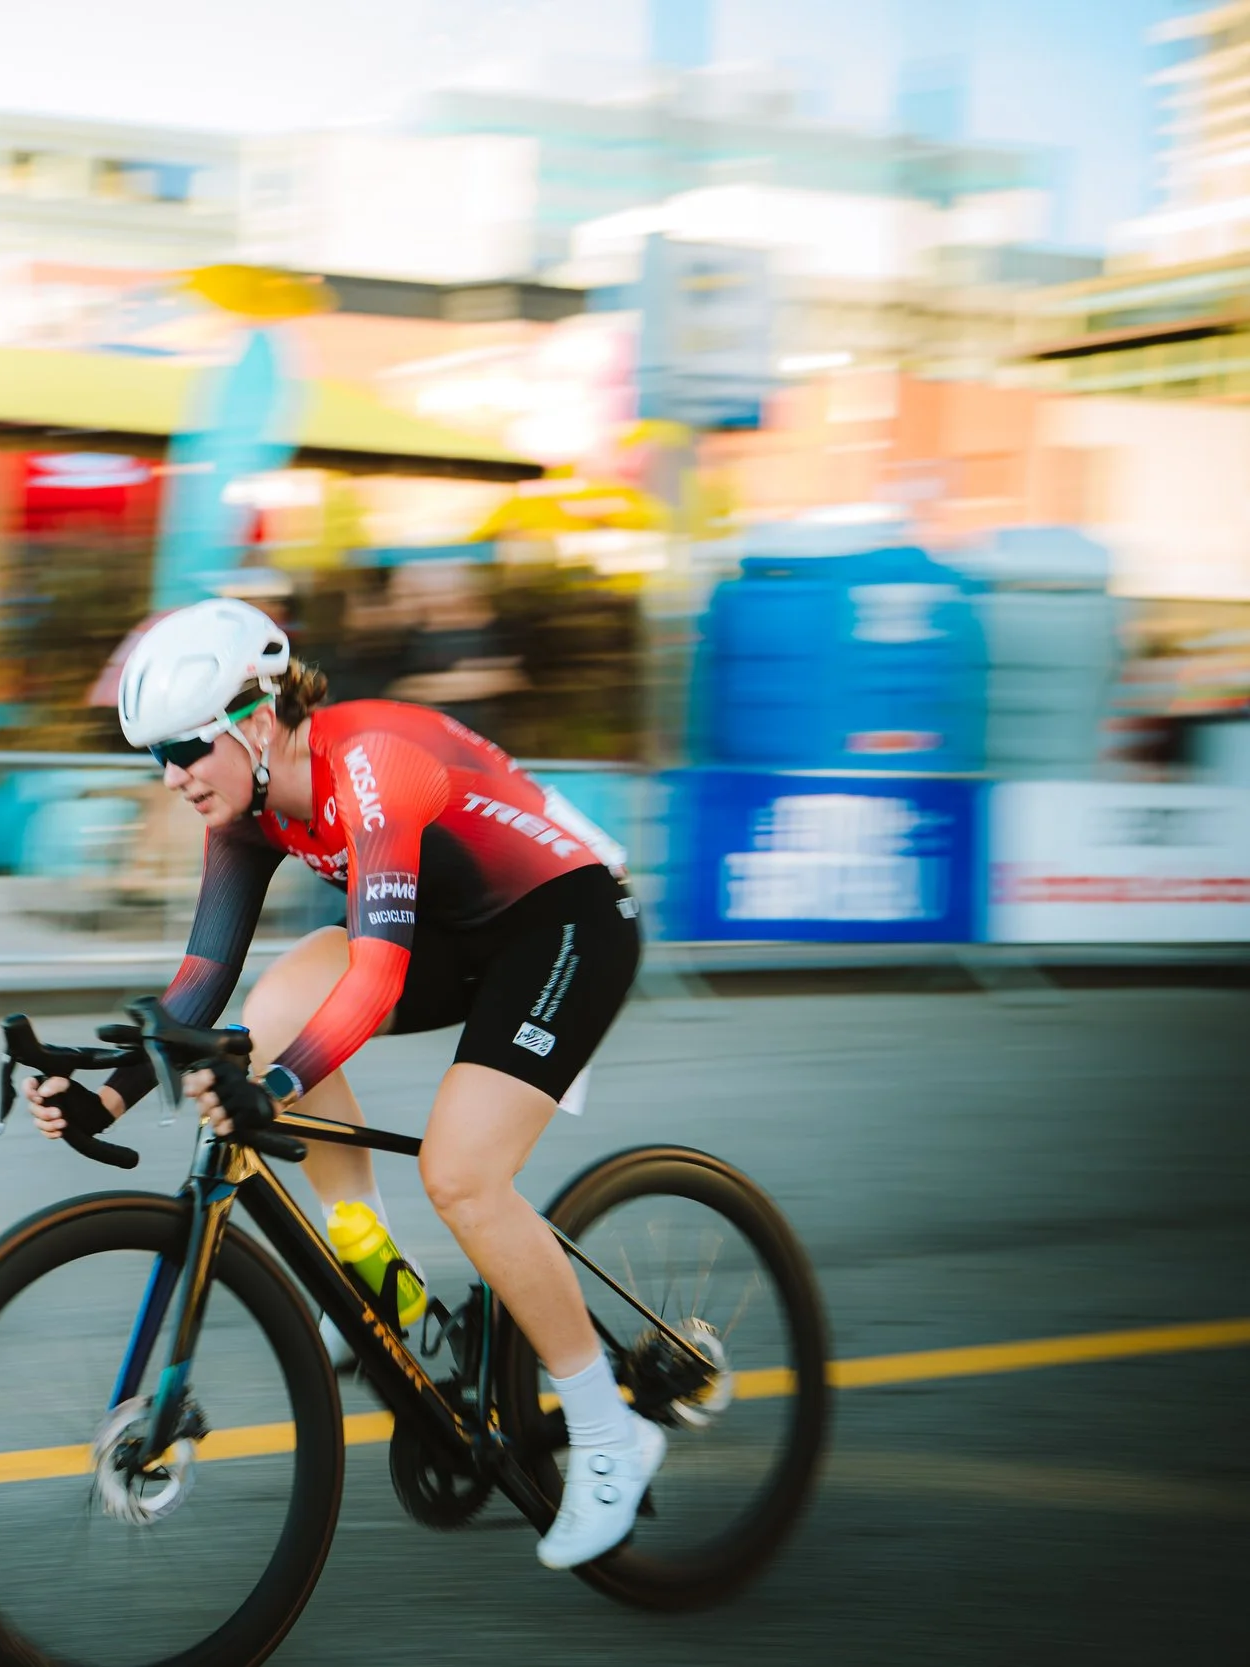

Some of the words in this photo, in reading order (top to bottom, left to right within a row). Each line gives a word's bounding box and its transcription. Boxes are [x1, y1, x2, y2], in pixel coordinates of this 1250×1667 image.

[343, 745, 386, 833] MOSAIC
[462, 791, 581, 859] TREK
[366, 881, 416, 901] KPMG
